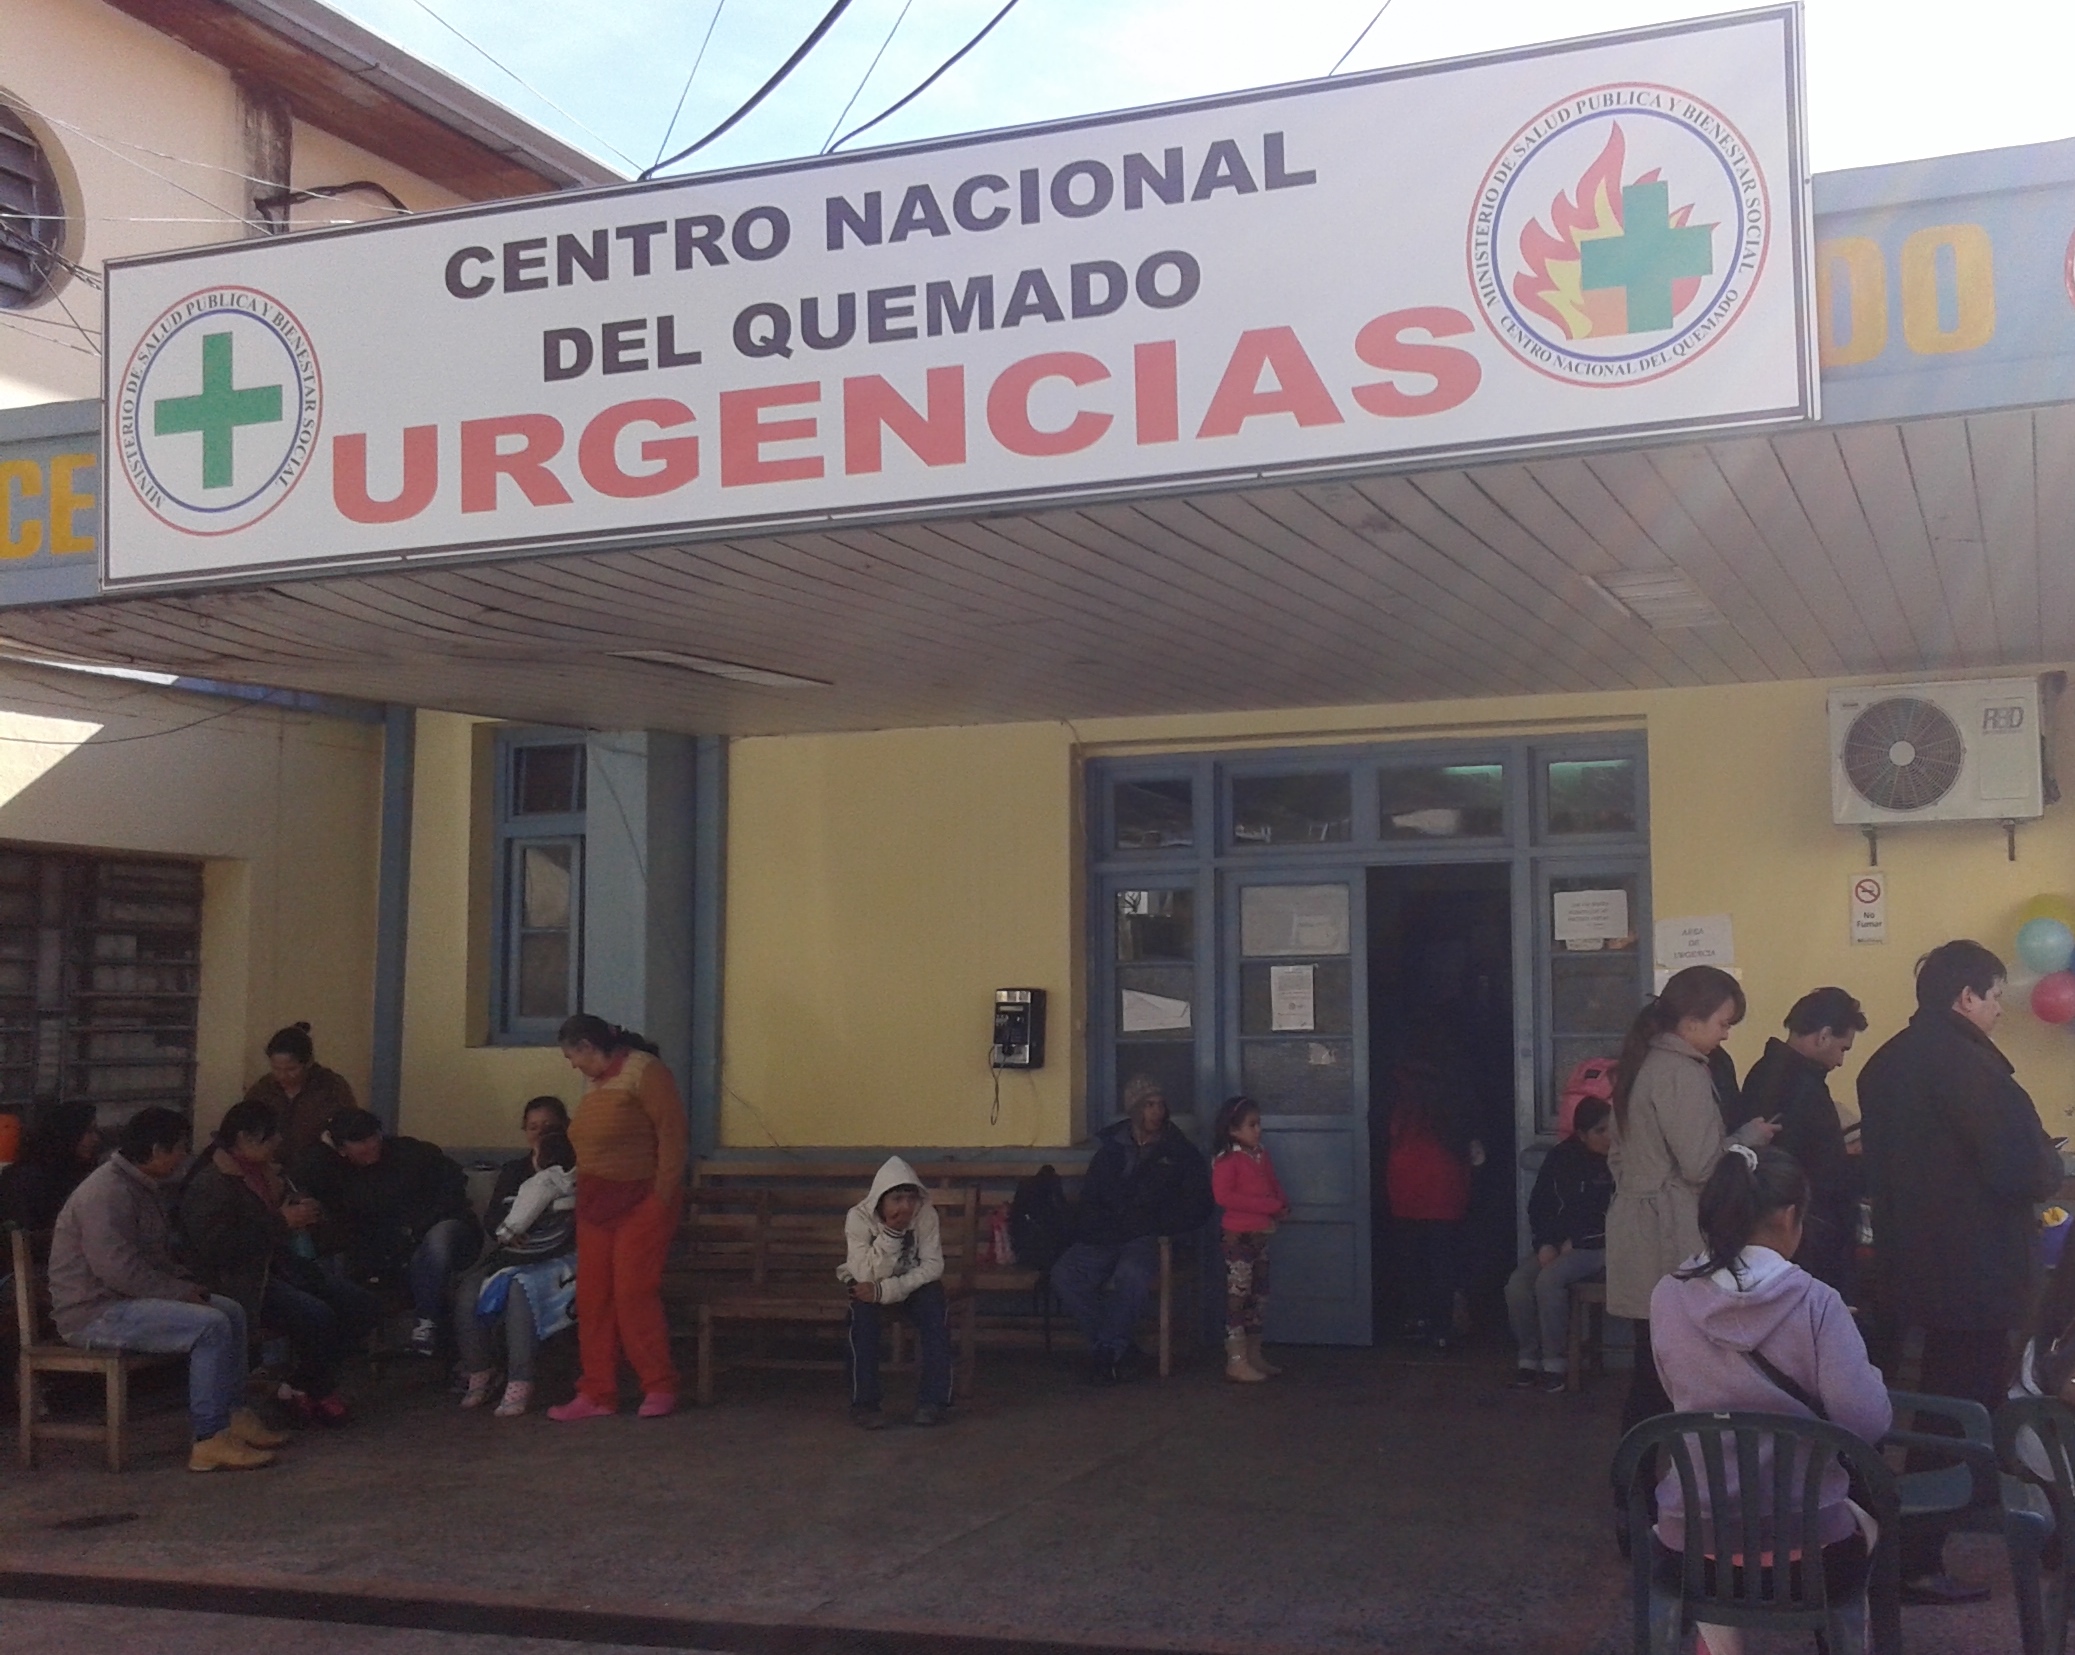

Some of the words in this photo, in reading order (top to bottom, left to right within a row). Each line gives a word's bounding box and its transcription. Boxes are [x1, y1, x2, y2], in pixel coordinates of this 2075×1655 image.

[445, 206, 791, 299] CENTRO
[825, 131, 1317, 251] NACIONAL
[1475, 187, 1500, 308] MINISTERIO
[1493, 158, 1516, 184] DE
[1512, 108, 1571, 156] SALUD
[1576, 90, 1662, 115] PUBLICA
[1668, 96, 1682, 111] Y
[1682, 104, 1757, 193] BIENESTAR
[1739, 194, 1762, 274] SOCIAL
[138, 311, 183, 364] SALUD
[185, 293, 256, 316] PUBLICA
[262, 302, 273, 317] Y
[543, 315, 702, 383] DEL
[732, 248, 1202, 359] QUEMADO
[1500, 314, 1553, 362] CENTRO
[1553, 352, 1638, 377] NACIONAL
[1640, 350, 1672, 372] DEL
[1672, 288, 1739, 357] QUEMADO
[126, 367, 143, 393] DE
[272, 311, 316, 411] BIENESTAR
[122, 399, 165, 508] MINISTERIO
[275, 418, 314, 487] SOCIAL
[332, 307, 1482, 524] URGENCIAS
[1856, 920, 1882, 928] Fumar
[1863, 911, 1875, 919] No
